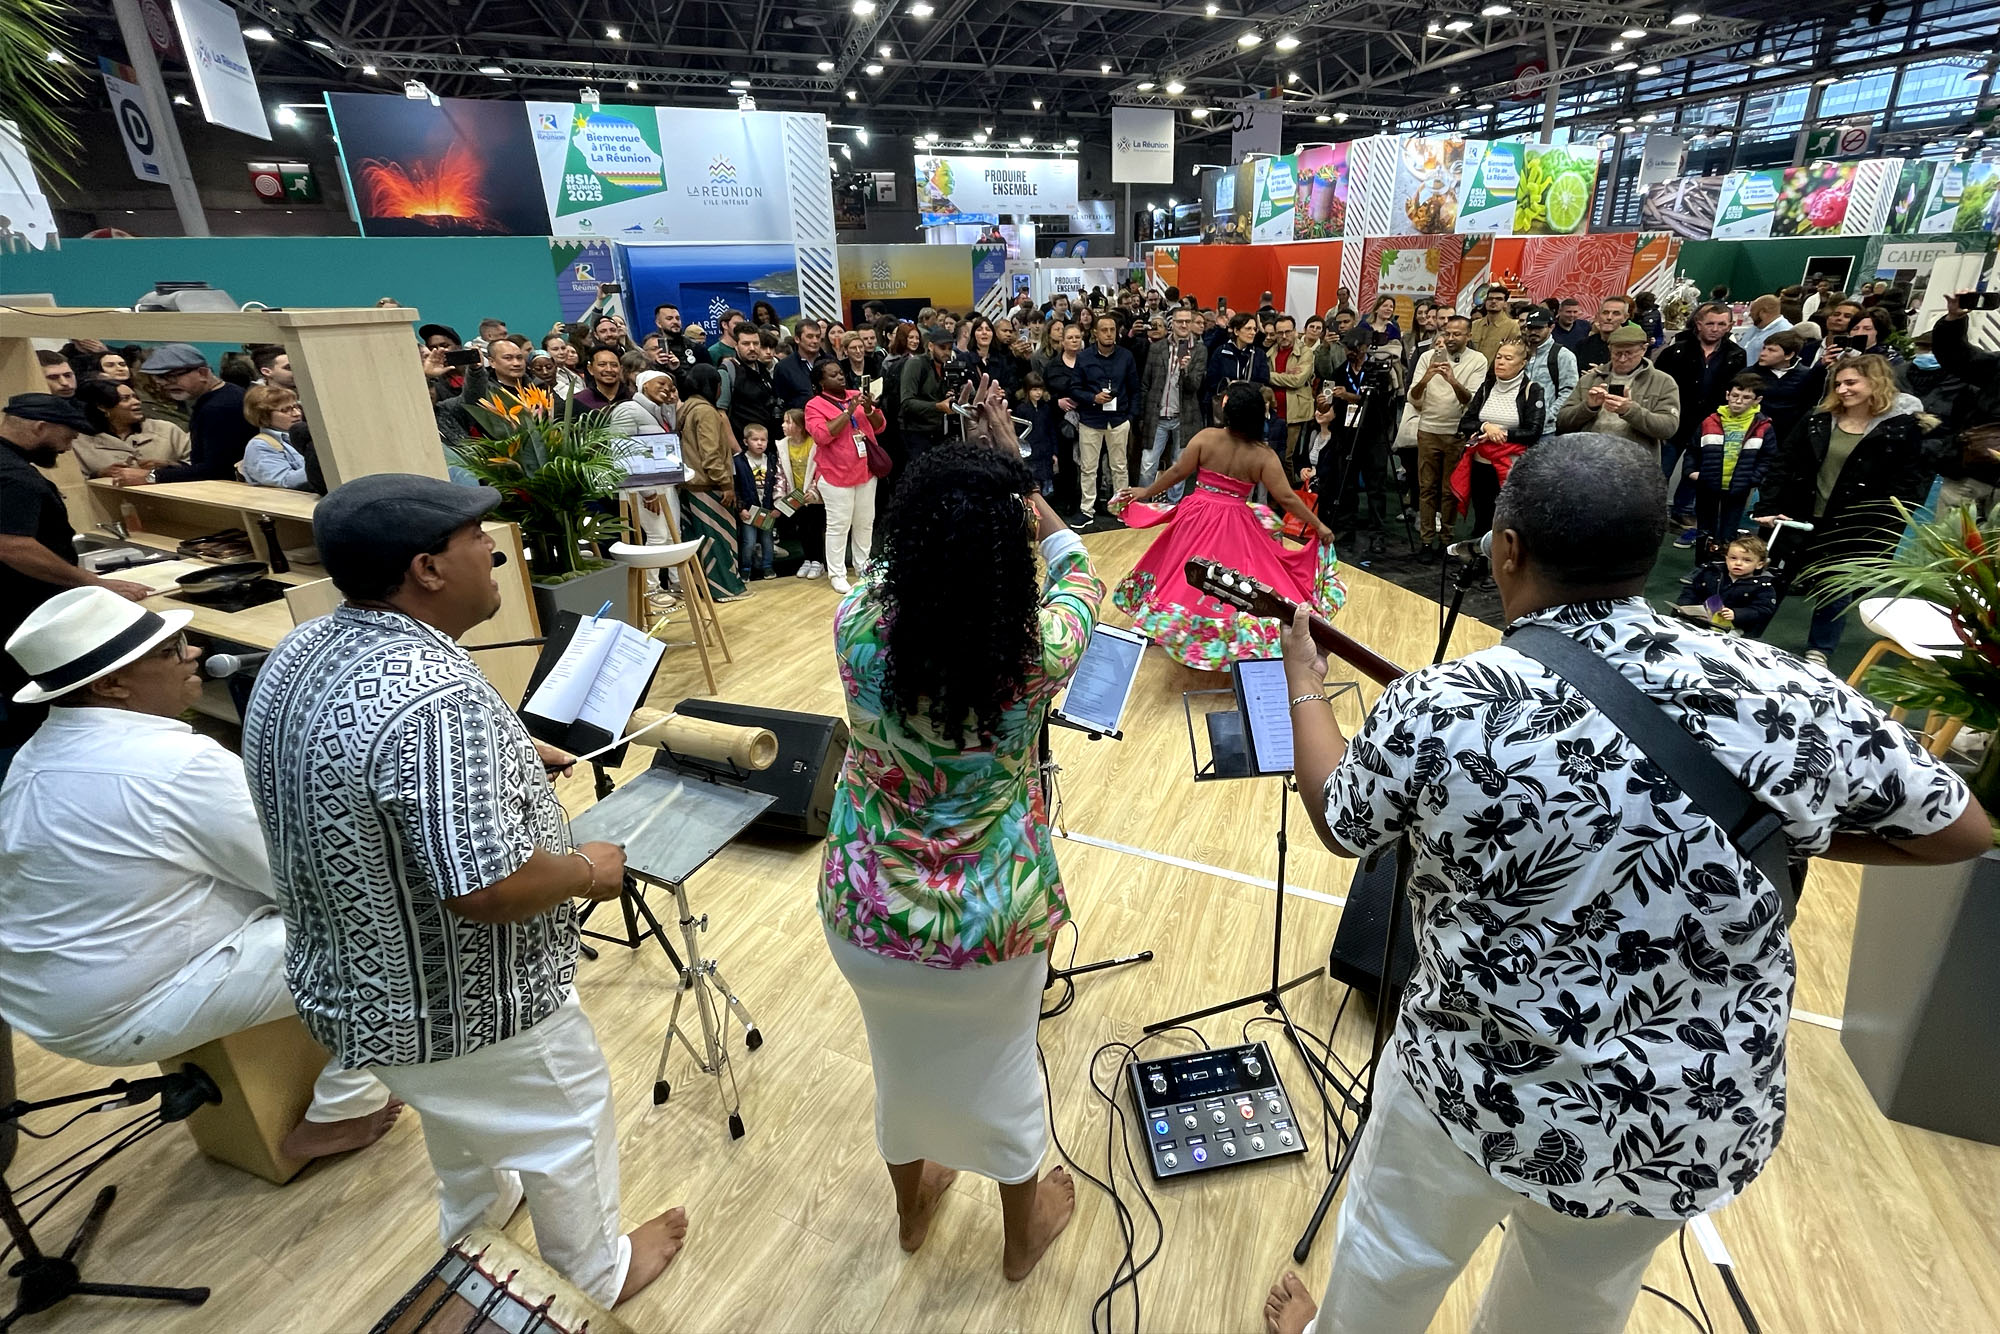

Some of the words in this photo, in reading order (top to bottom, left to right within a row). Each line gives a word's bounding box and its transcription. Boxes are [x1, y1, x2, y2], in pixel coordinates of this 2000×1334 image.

[586, 133, 640, 143] Bienvenue
[592, 143, 597, 151] à
[600, 143, 617, 152] l'île
[619, 144, 631, 152] de
[591, 153, 603, 162] La
[606, 153, 651, 163] Réunion
[565, 174, 601, 185] #SIA
[984, 169, 1027, 182] PRODUIRE
[687, 186, 699, 195] LA
[992, 183, 1038, 196] ENSEMBLE
[568, 190, 604, 202] 2025
[1055, 276, 1081, 284] PRODUIRE
